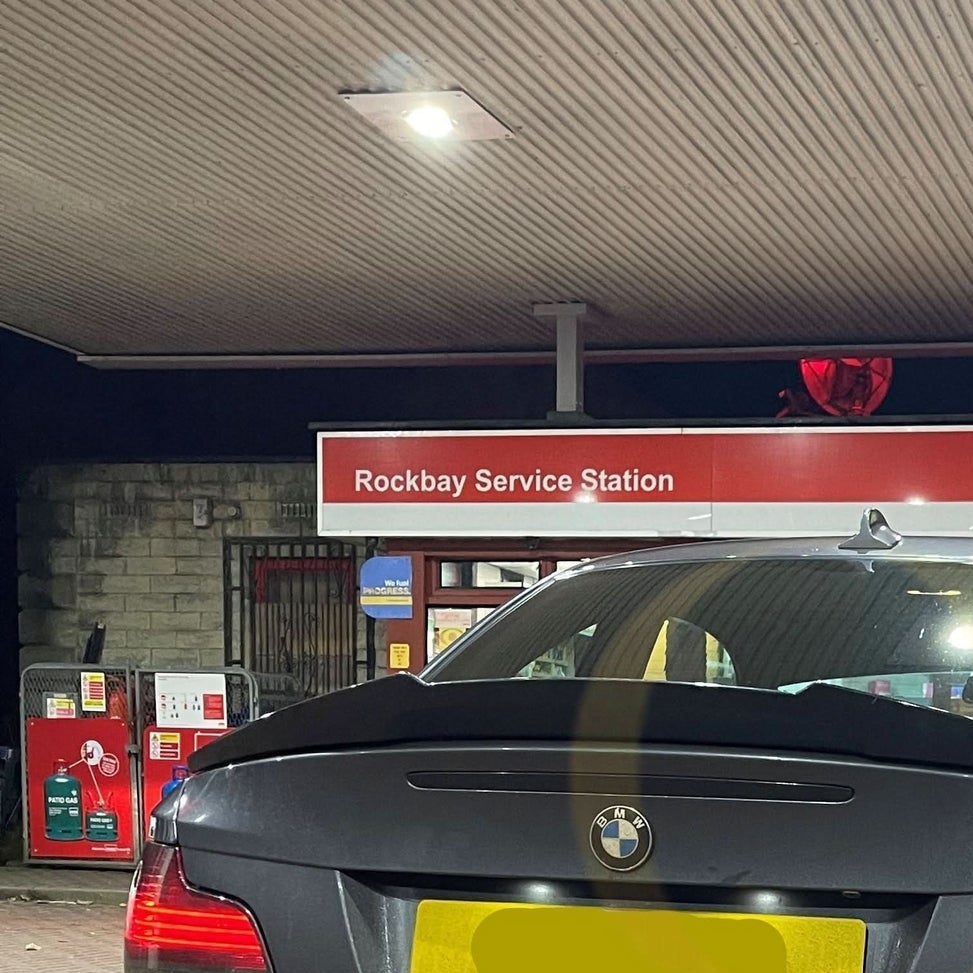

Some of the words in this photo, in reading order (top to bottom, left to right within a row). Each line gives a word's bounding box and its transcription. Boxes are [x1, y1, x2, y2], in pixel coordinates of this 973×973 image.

[355, 469, 466, 497] Rockbay
[475, 468, 573, 493] Service
[580, 468, 674, 493] Station
[384, 579, 395, 587] We
[596, 807, 645, 829] BMW
